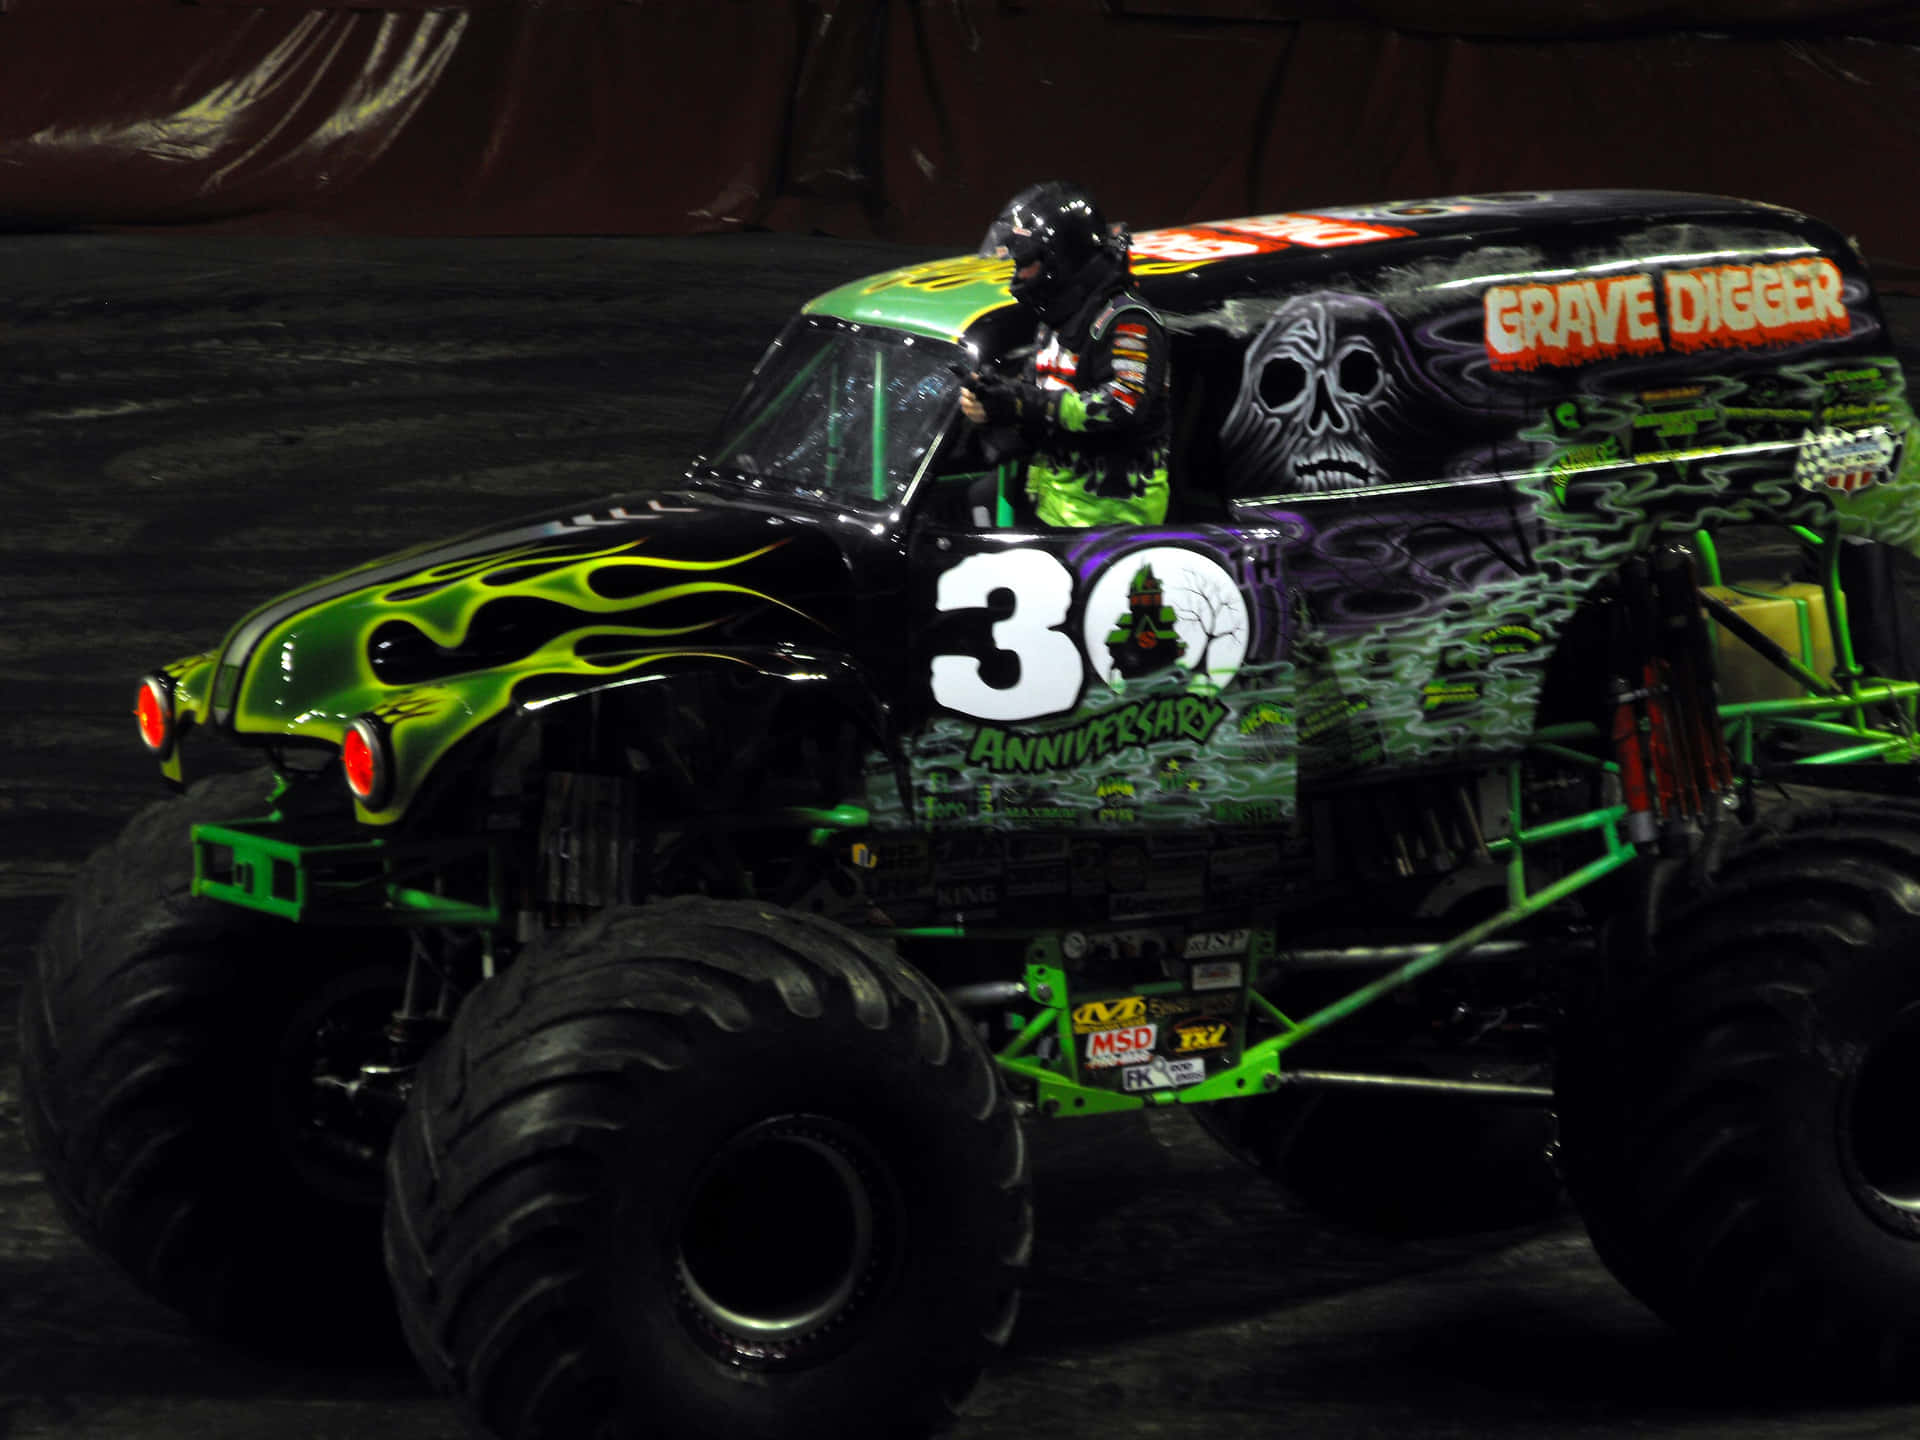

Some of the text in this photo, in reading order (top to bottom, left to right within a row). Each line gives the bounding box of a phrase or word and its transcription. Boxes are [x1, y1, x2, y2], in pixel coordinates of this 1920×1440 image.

[1486, 258, 1847, 355] GRAVE DIGGER
[966, 695, 1231, 773] ANNIVERSARY
[1093, 1028, 1152, 1055] MSD
